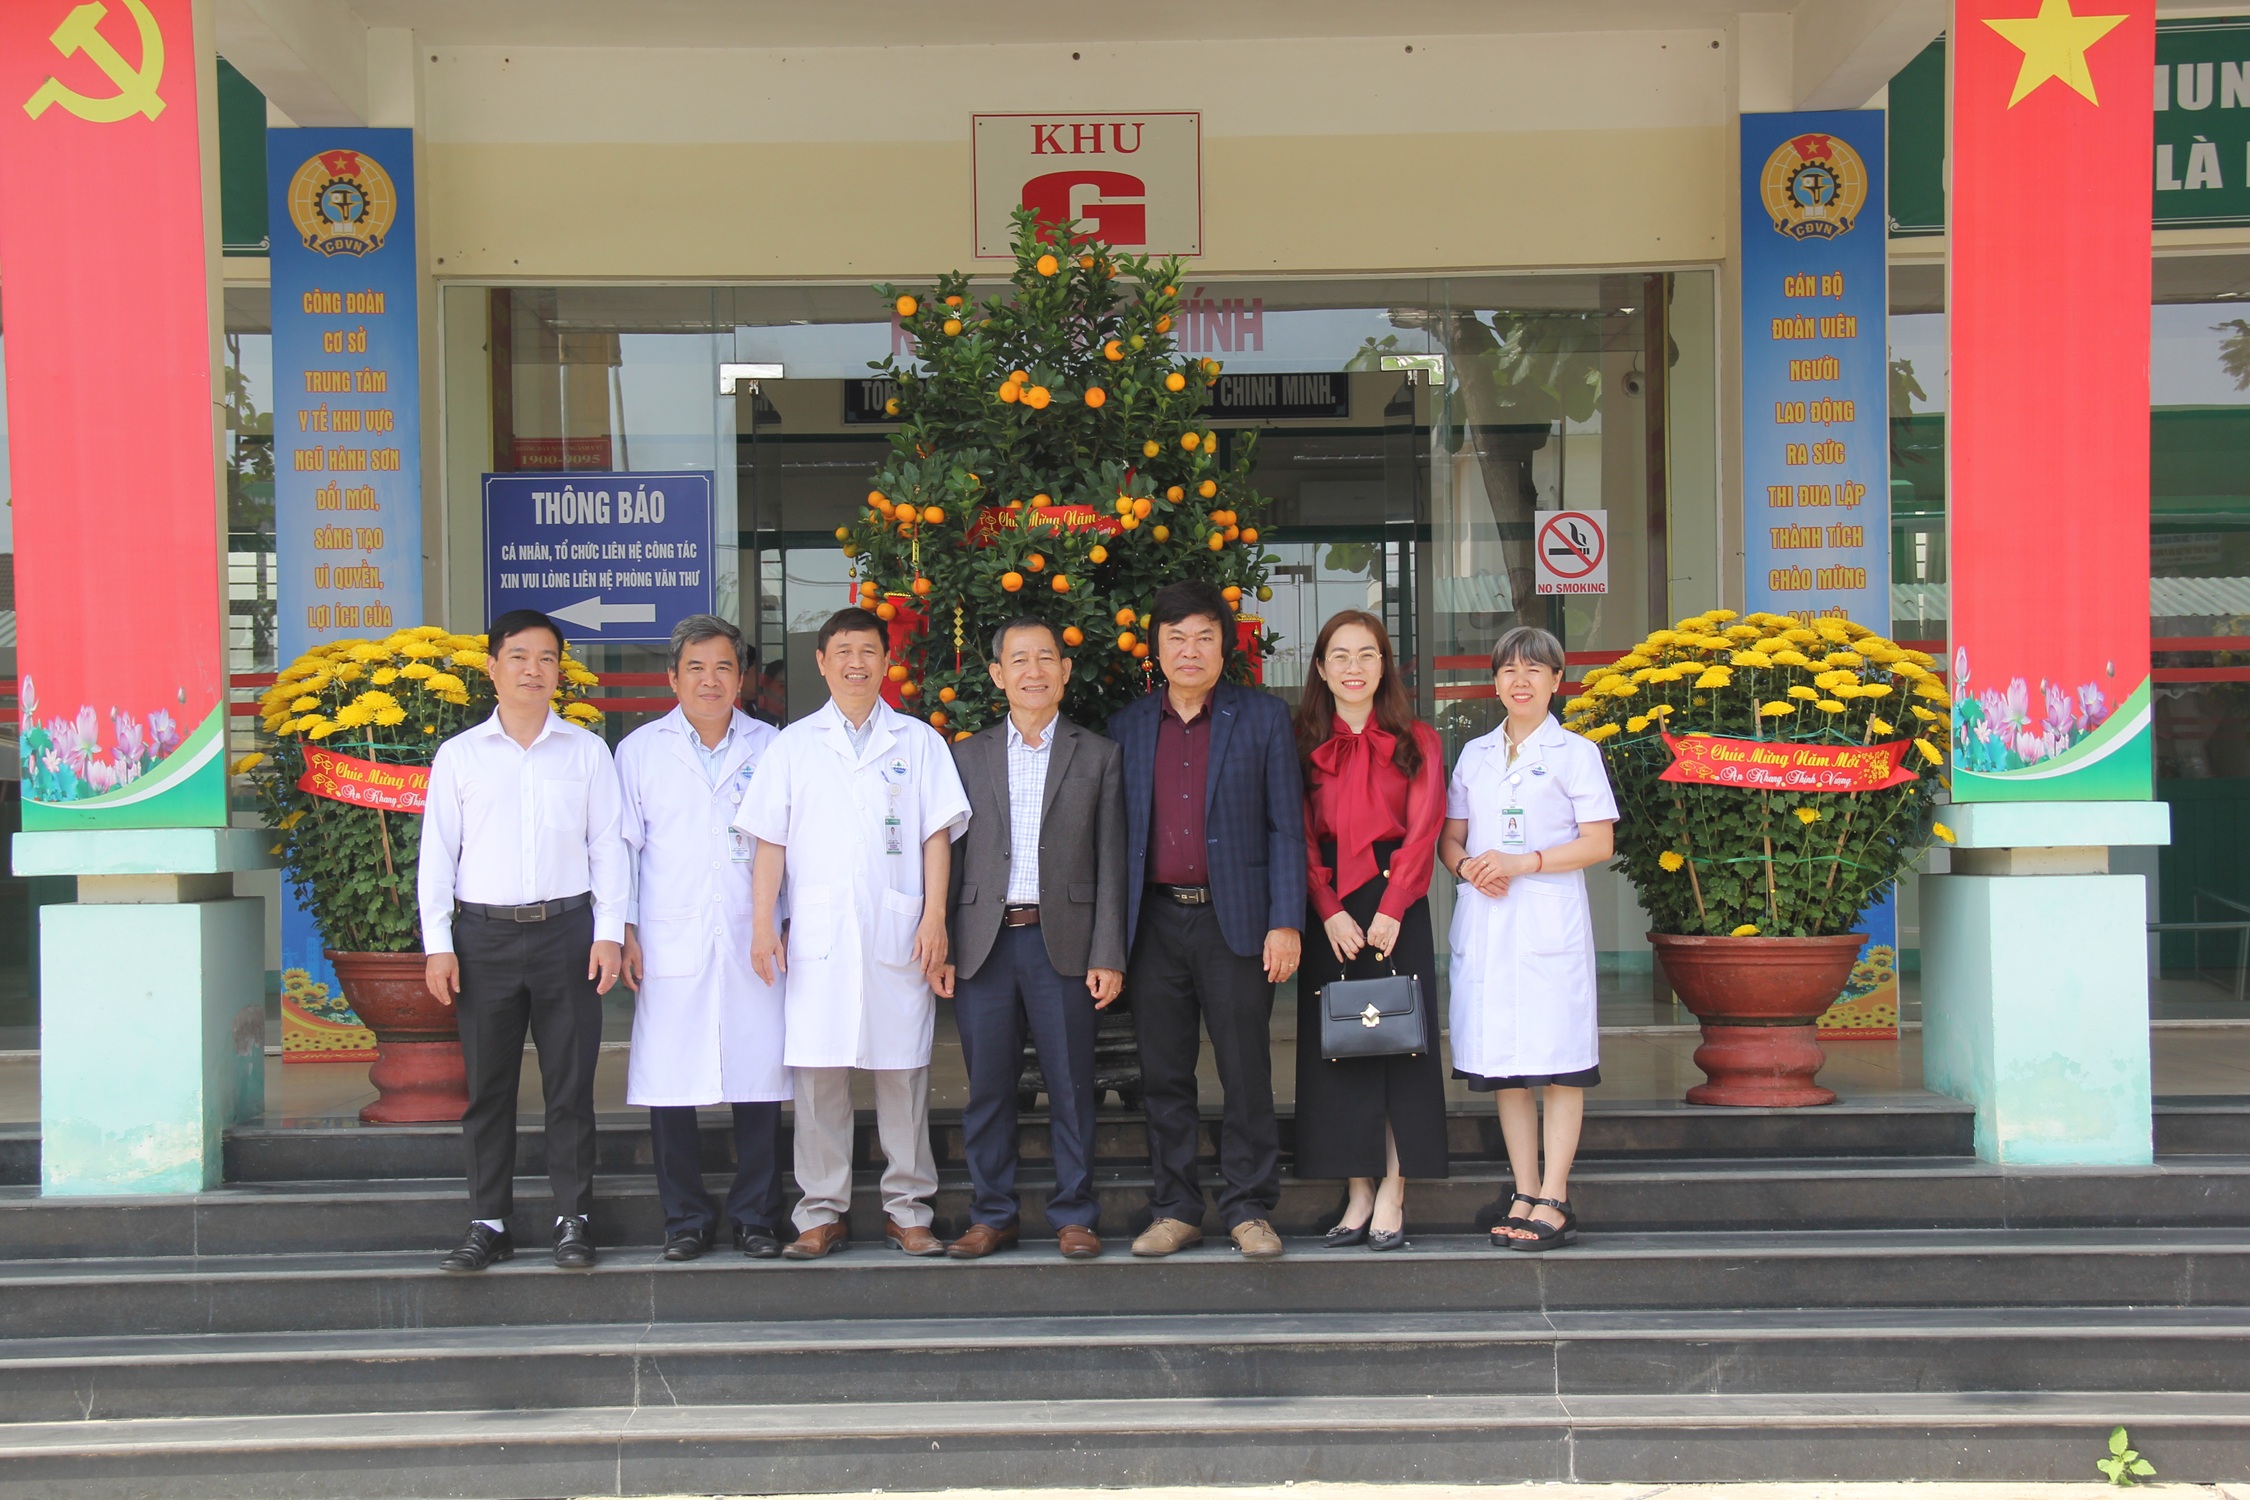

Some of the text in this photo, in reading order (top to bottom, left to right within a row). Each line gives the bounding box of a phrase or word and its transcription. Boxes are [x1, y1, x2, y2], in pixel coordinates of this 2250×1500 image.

[1030, 122, 1146, 155] KHU
[2156, 135, 2223, 191] LÀ
[1021, 170, 1147, 246] G
[1796, 222, 1833, 236] CĐVN
[326, 237, 362, 252] CĐVN
[1784, 270, 1843, 301] CÁN BỘ
[303, 288, 385, 314] CÔNG ĐOÀN
[1166, 286, 1264, 353] HÍNH
[1772, 312, 1857, 340] ĐOÀN VIÊN
[323, 325, 367, 354] CƠ SỞ
[304, 366, 387, 392] TRUNG TÂM
[1789, 355, 1839, 381] NGƯỜI
[298, 402, 394, 436] Y TẾ KHU VỰC
[1775, 396, 1855, 427] LAO ĐỘNG
[294, 445, 400, 471] NGŨ HÀNH SƠN
[1786, 438, 1845, 465] RA SỨC
[316, 480, 380, 512] ĐỔI MỚI,
[531, 483, 666, 525] THÔNG BÁO
[1767, 480, 1866, 510] THI ĐUA LẬP
[1063, 510, 1096, 526] Năm
[314, 523, 384, 554] SÁNG TẠO
[1769, 521, 1863, 549] THÀNH TÍCH
[501, 538, 698, 563] CÁ NHÂN, TỔ CHỨC LIÊN HỆ CÔNG TÁC
[315, 559, 384, 590] VÌ QUYỀN,
[500, 568, 701, 591] XIN VUI LÒNG LIÊN HỆ PHÒNG VĂN THƯ
[1537, 582, 1606, 594] NO SMOKING
[1769, 564, 1866, 591] CHÀO MỪNG
[308, 600, 393, 632] LỢI ÍCH CỦA
[1710, 743, 1861, 769] Chúc Mừng Năm Mới
[335, 761, 363, 782] Chúc
[365, 768, 405, 790] Mừng
[400, 791, 427, 807] Thịn
